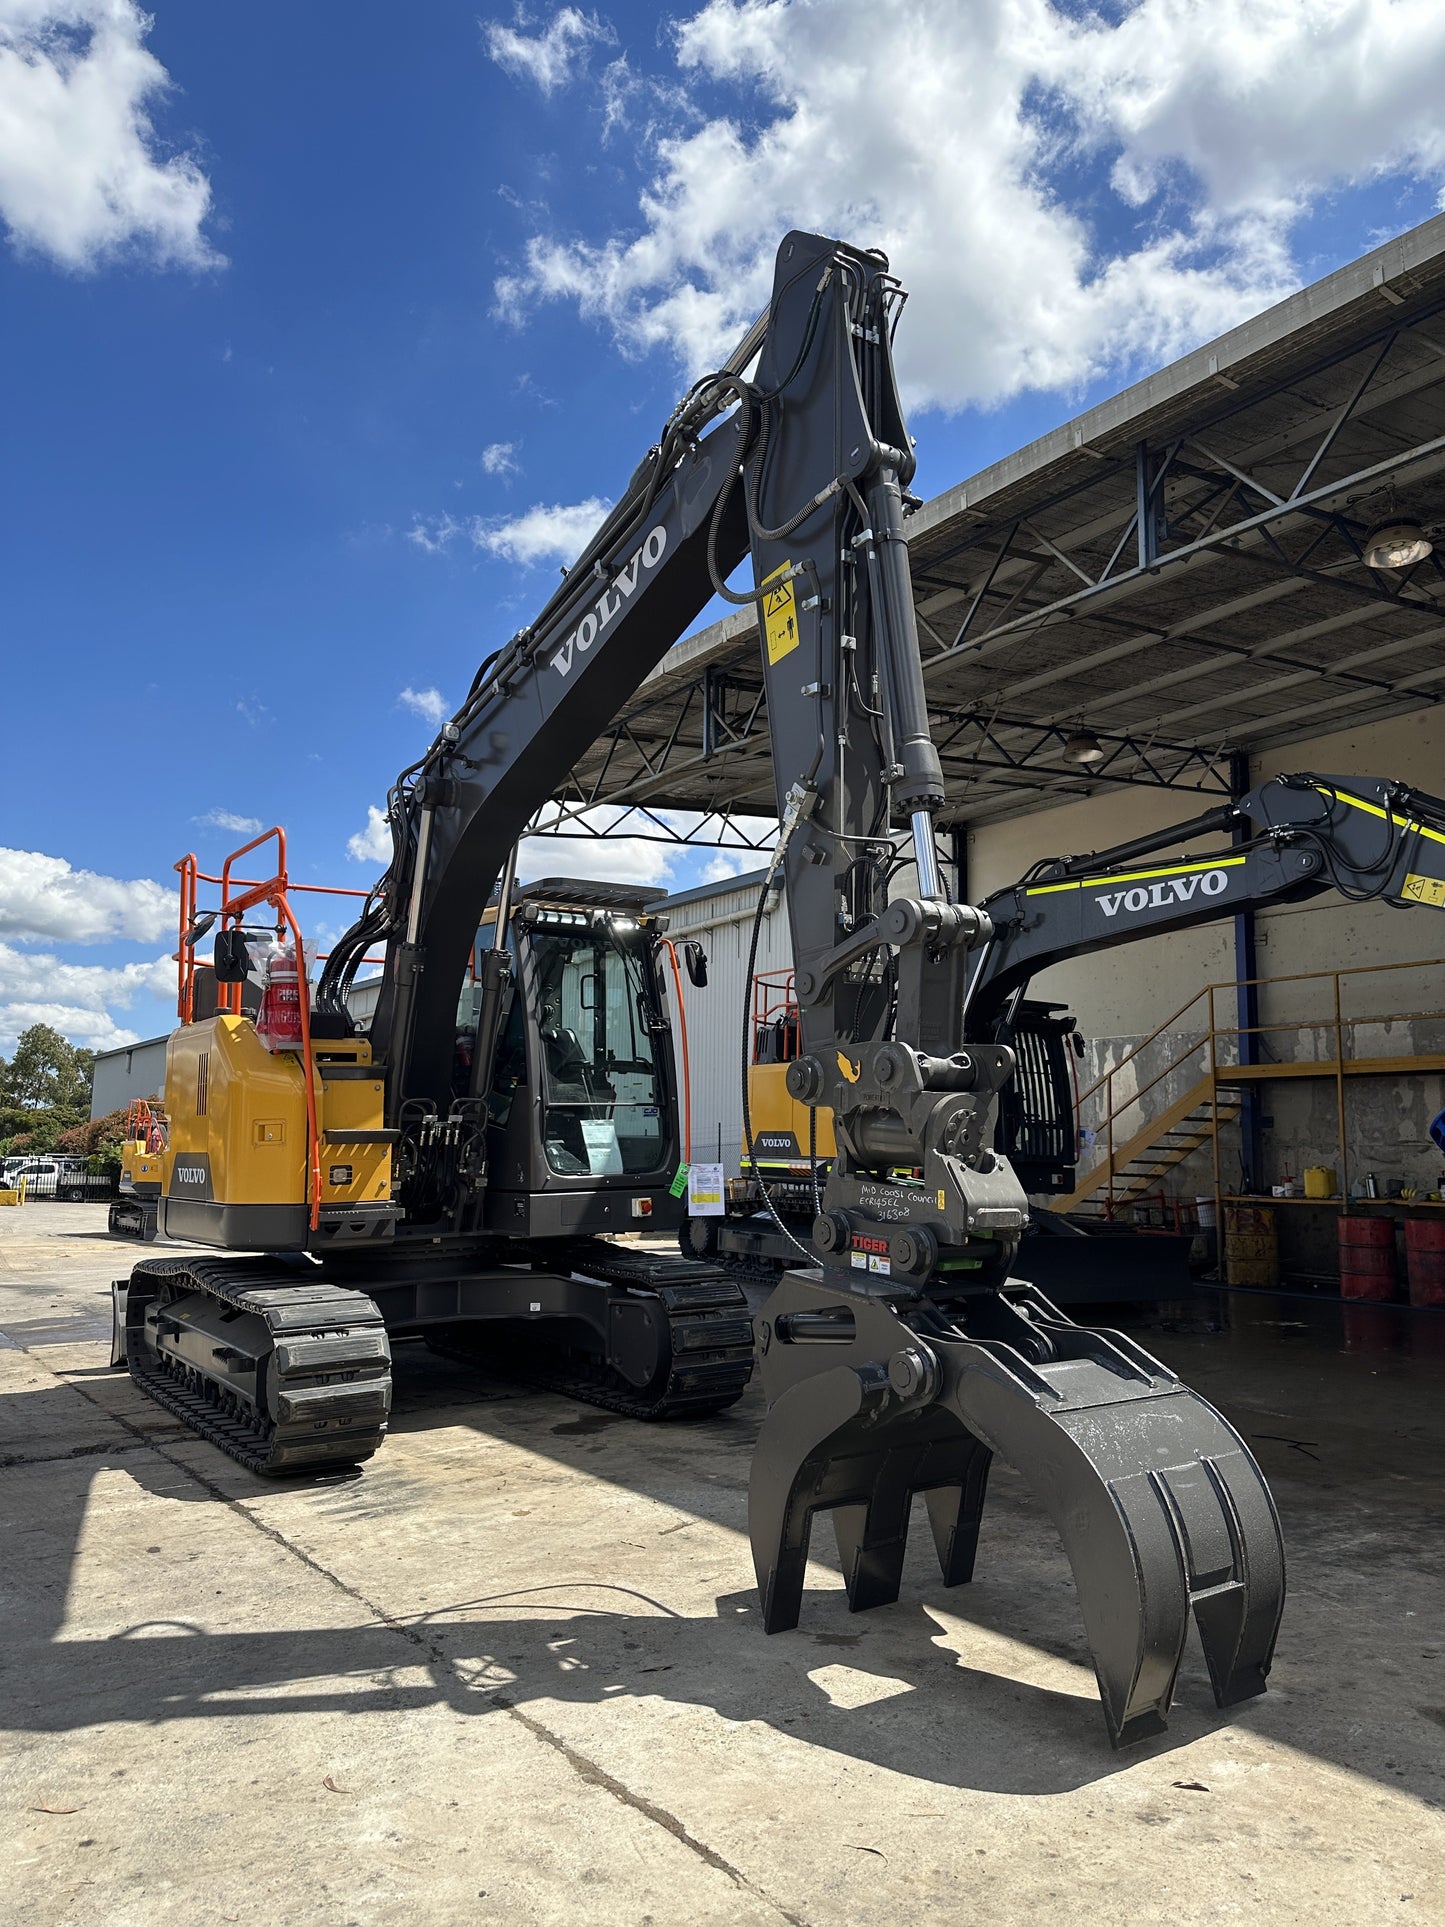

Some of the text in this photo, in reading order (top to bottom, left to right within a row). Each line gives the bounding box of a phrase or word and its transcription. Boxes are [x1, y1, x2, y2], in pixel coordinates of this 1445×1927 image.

[550, 525, 667, 677] VOLVO
[1095, 870, 1229, 917] VOLVO
[761, 1138, 791, 1148] VOLVO
[177, 1167, 206, 1184] VOLVO
[877, 1206, 910, 1222] 316308
[851, 1235, 888, 1253] TIGER
